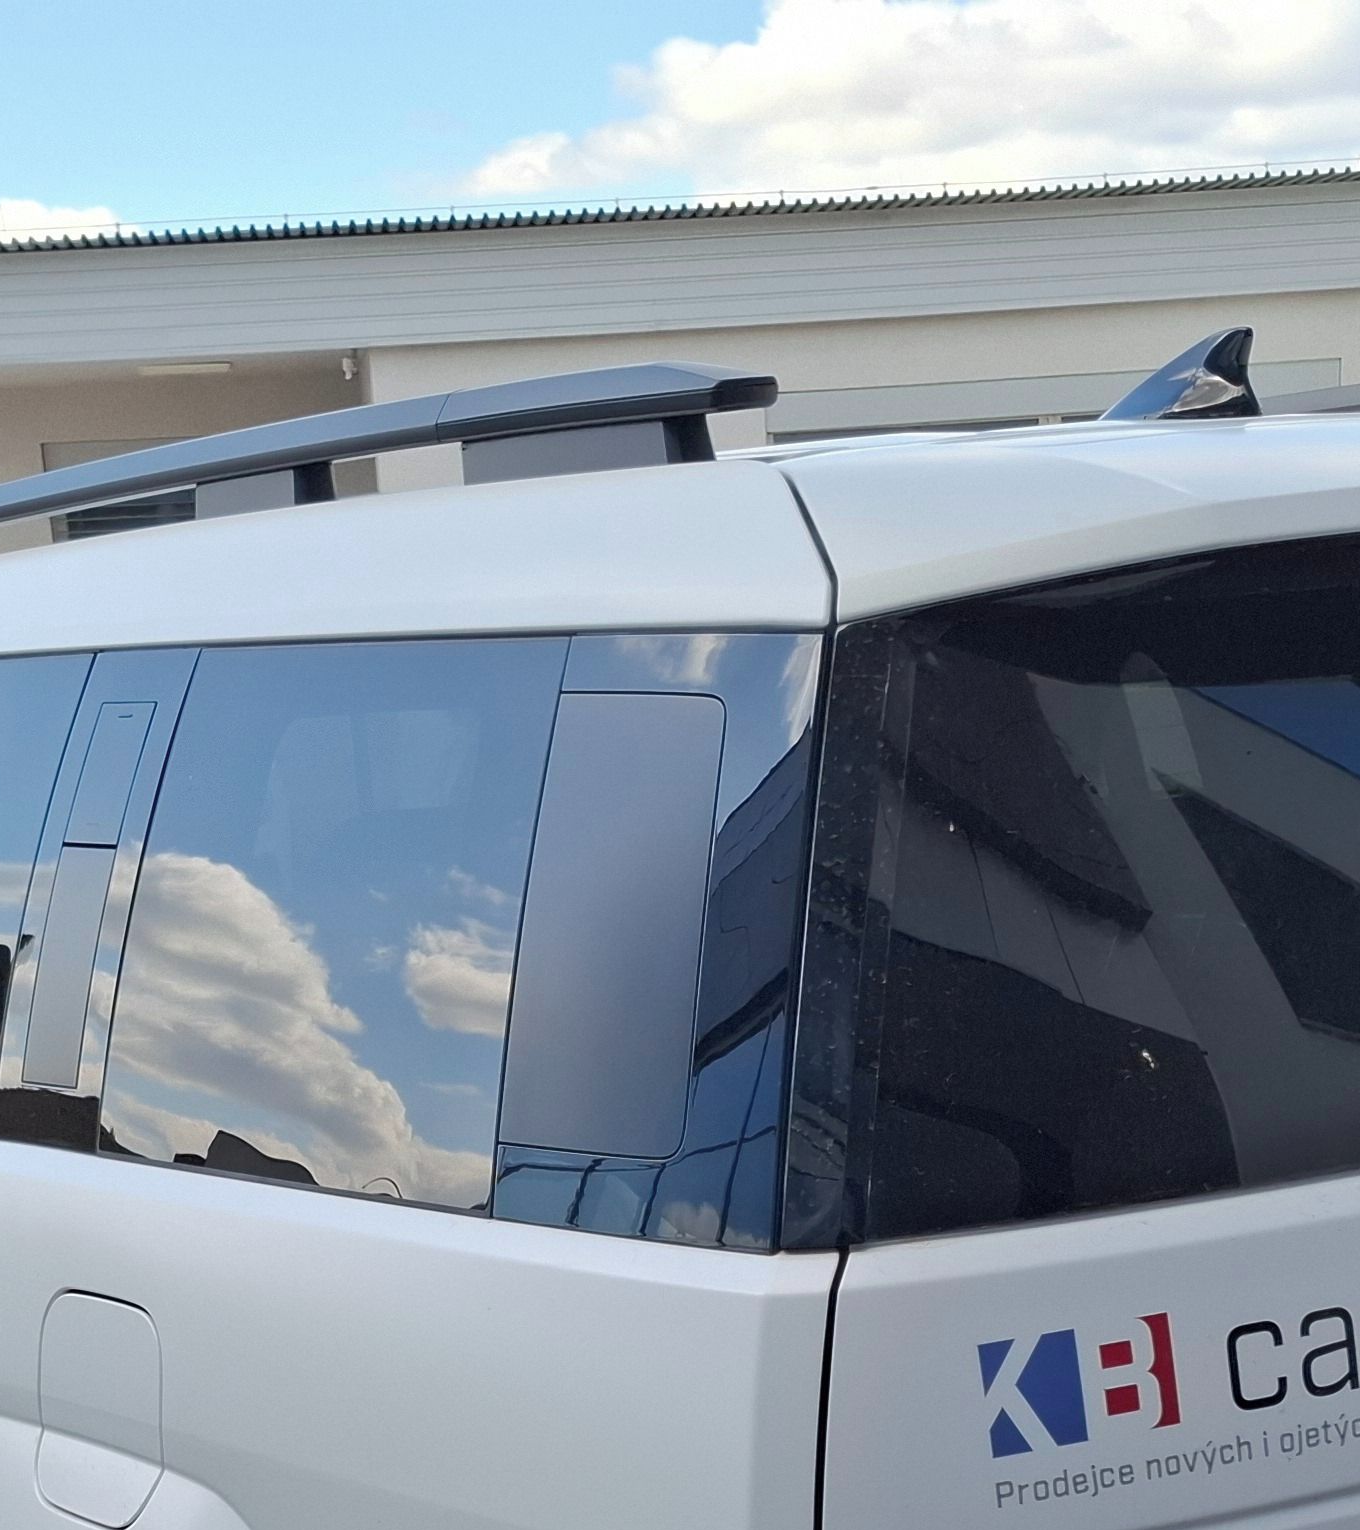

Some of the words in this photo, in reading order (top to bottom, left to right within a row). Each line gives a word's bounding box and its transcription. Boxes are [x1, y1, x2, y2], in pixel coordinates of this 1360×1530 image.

[976, 1312, 1181, 1460] KB
[994, 1458, 1136, 1509] Prodejce
[1145, 1433, 1253, 1480] nových
[1262, 1430, 1271, 1457] i
